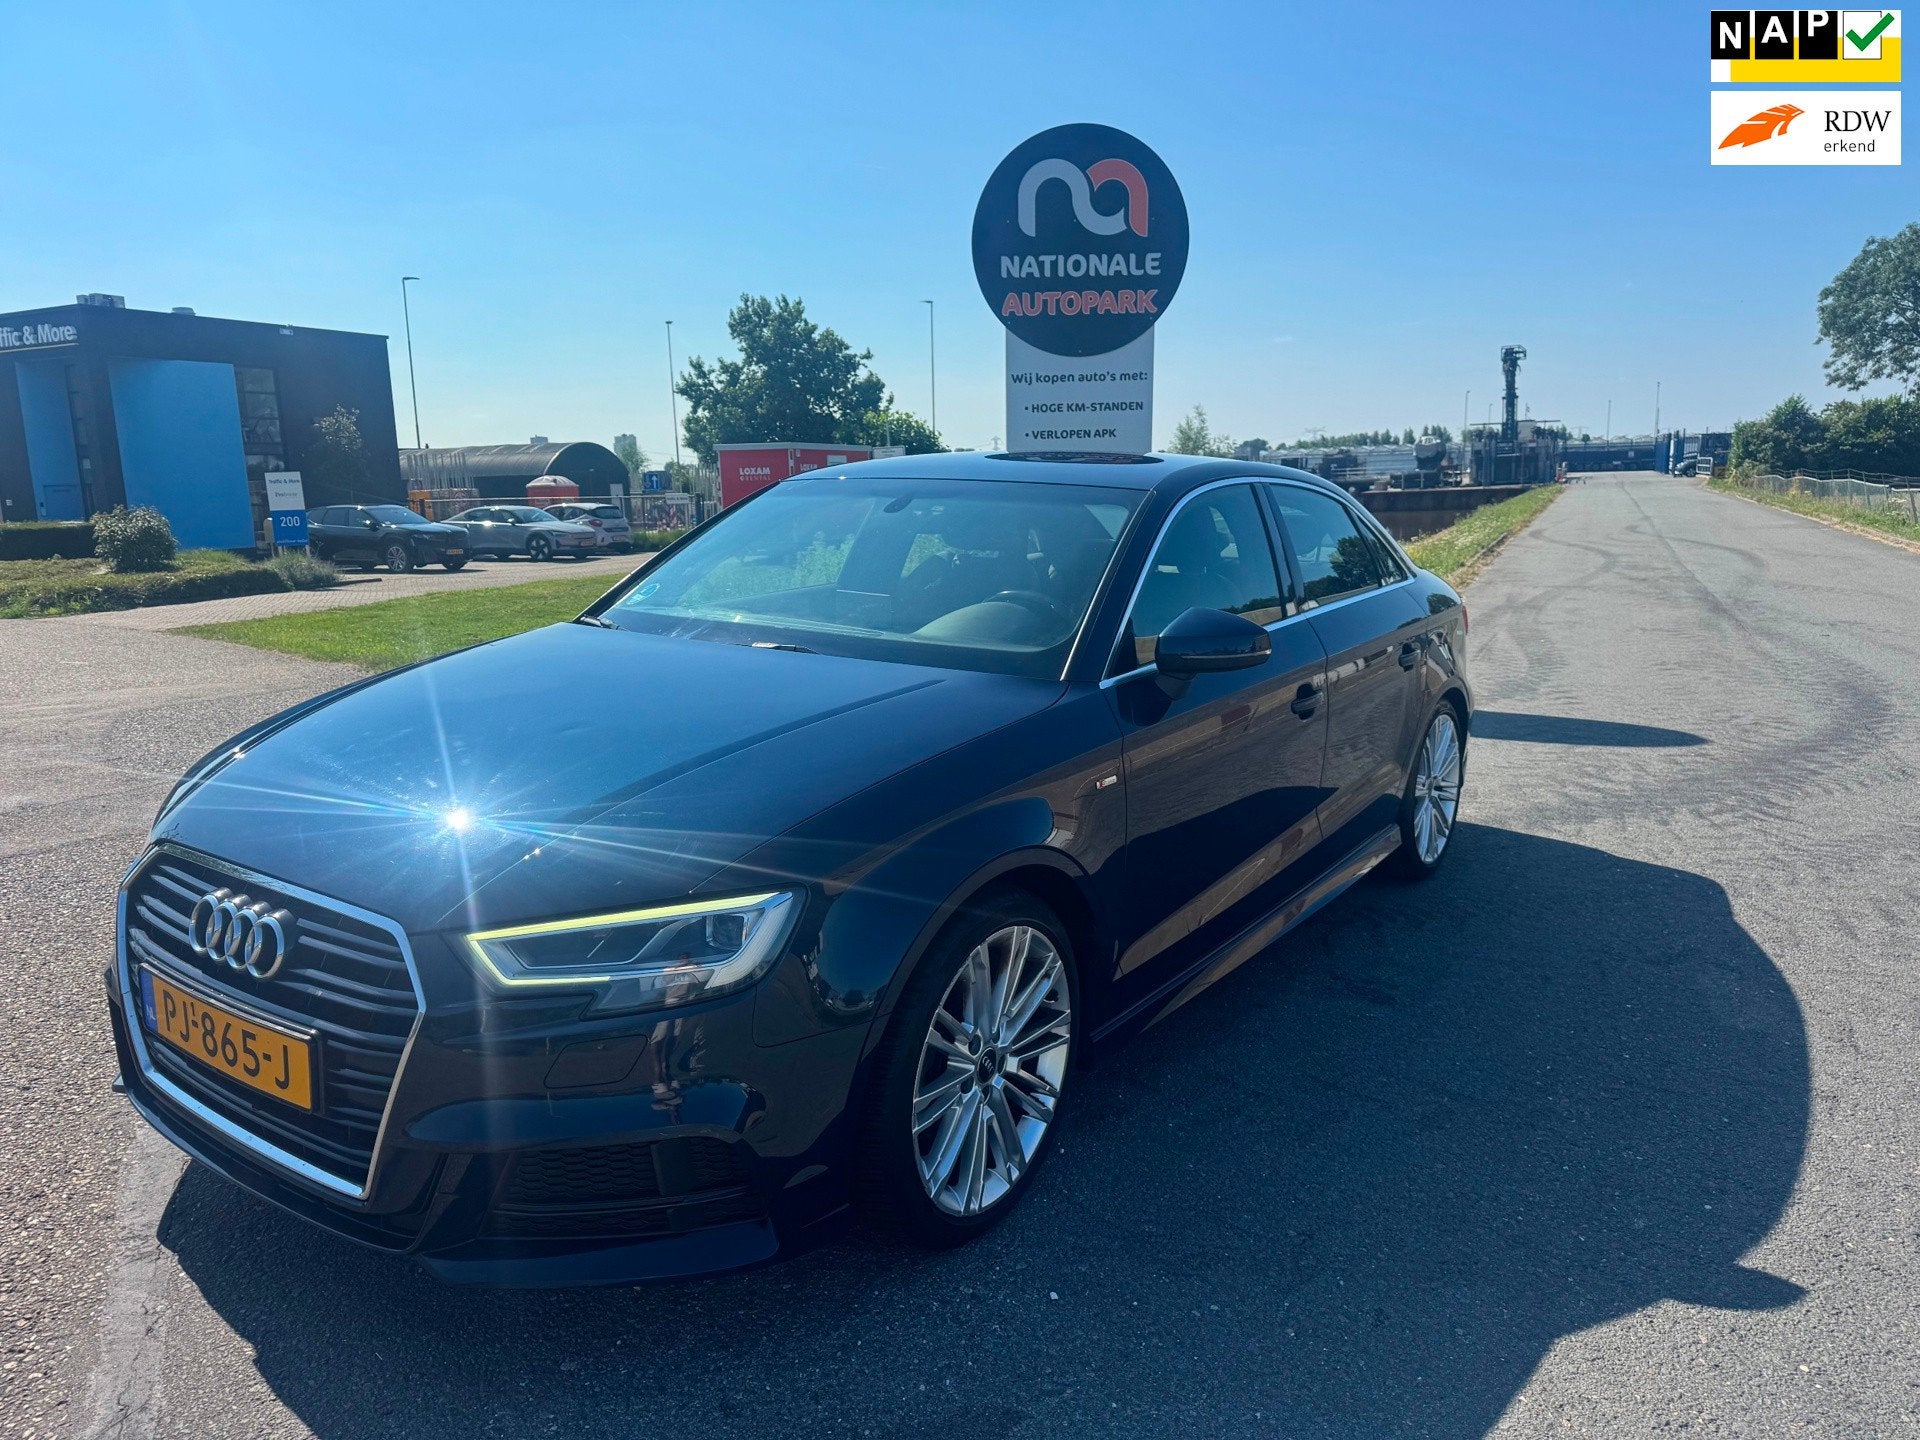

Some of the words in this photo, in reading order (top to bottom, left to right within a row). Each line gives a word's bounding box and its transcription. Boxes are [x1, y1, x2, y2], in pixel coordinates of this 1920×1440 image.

[1000, 252, 1162, 279] NATIONALE
[1001, 289, 1159, 317] AUTOPARK
[22, 325, 35, 345] &
[37, 323, 77, 343] More
[1011, 372, 1032, 386] Wij
[1035, 372, 1075, 385] kopen
[1078, 371, 1116, 382] auto's
[1119, 370, 1149, 381] met:
[1031, 403, 1063, 413] HOGE
[1066, 401, 1144, 413] KM-STANDEN
[1032, 429, 1091, 440] VERLOPEN
[1093, 428, 1117, 438] APK
[739, 467, 771, 475] LOXAM
[280, 516, 300, 526] 200
[162, 989, 291, 1090] PJ-865-J
